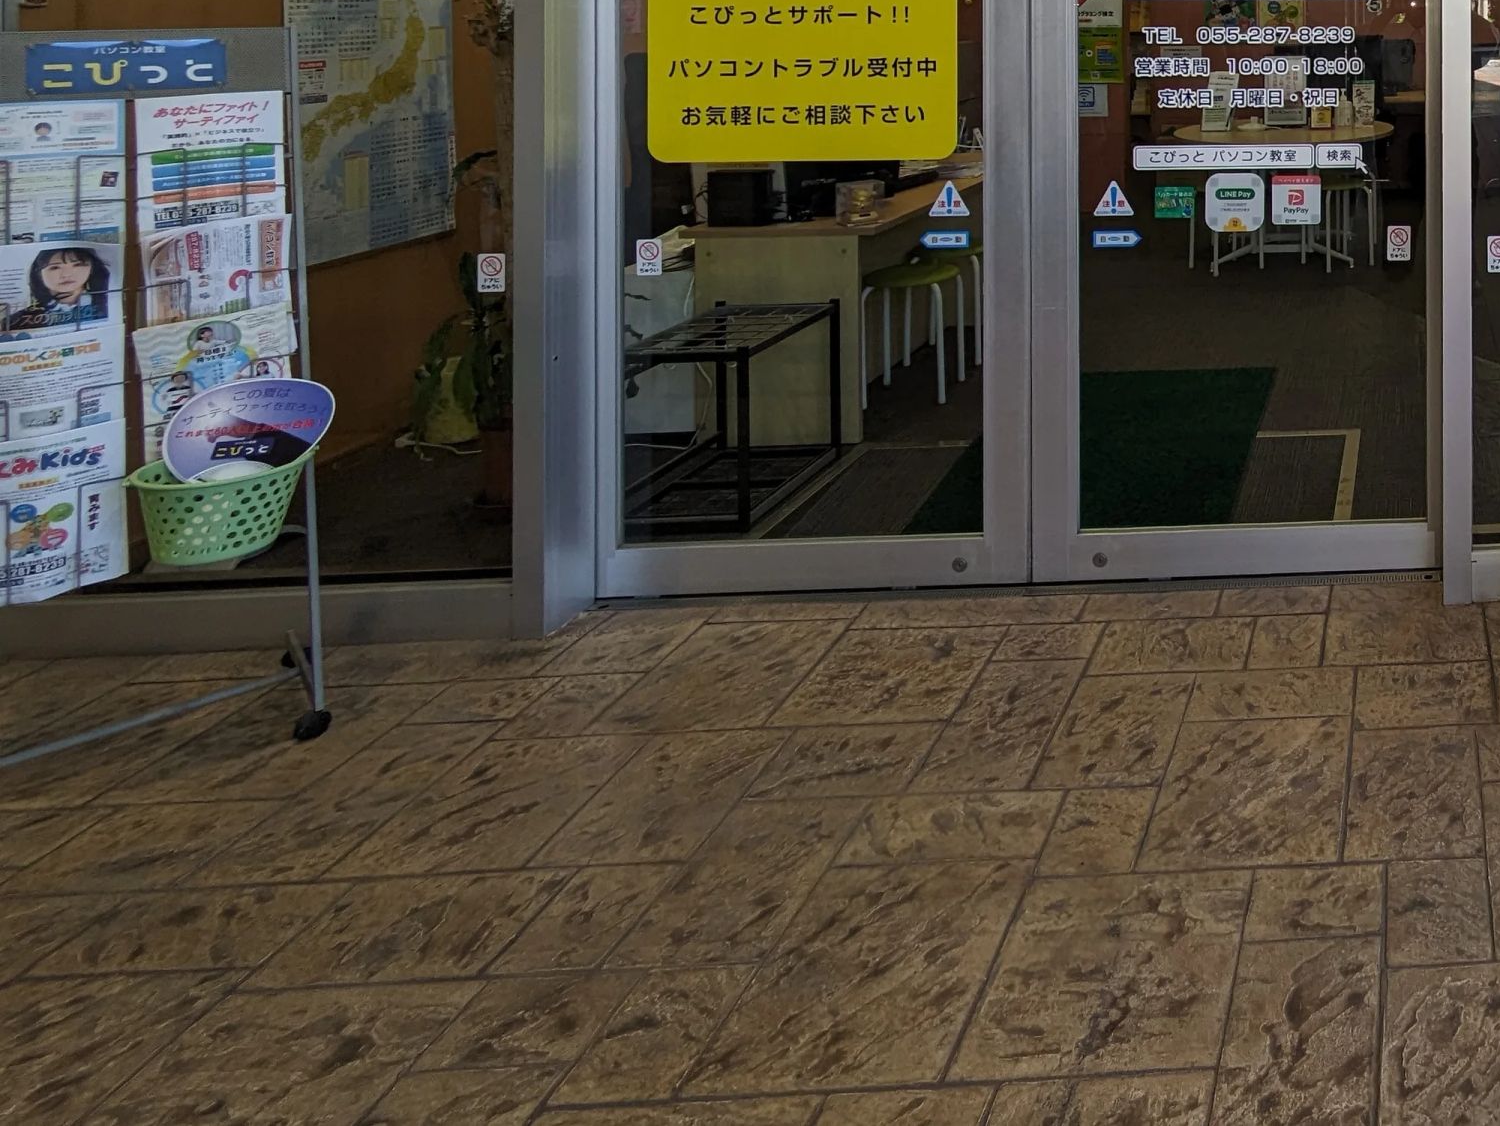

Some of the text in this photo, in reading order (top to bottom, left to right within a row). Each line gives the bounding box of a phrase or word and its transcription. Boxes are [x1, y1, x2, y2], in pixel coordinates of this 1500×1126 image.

[689, 4, 911, 25] こぴっとサポート!!
[1142, 26, 1356, 45] TEL 055-287-8239
[93, 45, 167, 55] パソコン教室
[42, 58, 214, 89] こぴっと
[668, 57, 939, 79] パソコントラブル受付中
[1135, 57, 1209, 77] 営業時間
[1157, 88, 1215, 109] 定休日
[1229, 88, 1341, 109] 月曜日・祝日
[152, 100, 271, 118] あなたにファイト！
[681, 104, 926, 126] お気軽にご相談下さい
[174, 114, 260, 129] サーティファイ
[1148, 148, 1297, 164] こぴっと パソコン教室
[1326, 148, 1353, 163] 検索
[1284, 207, 1309, 215] PayPay
[233, 386, 292, 402] この夏は
[213, 443, 270, 459] こぴっと
